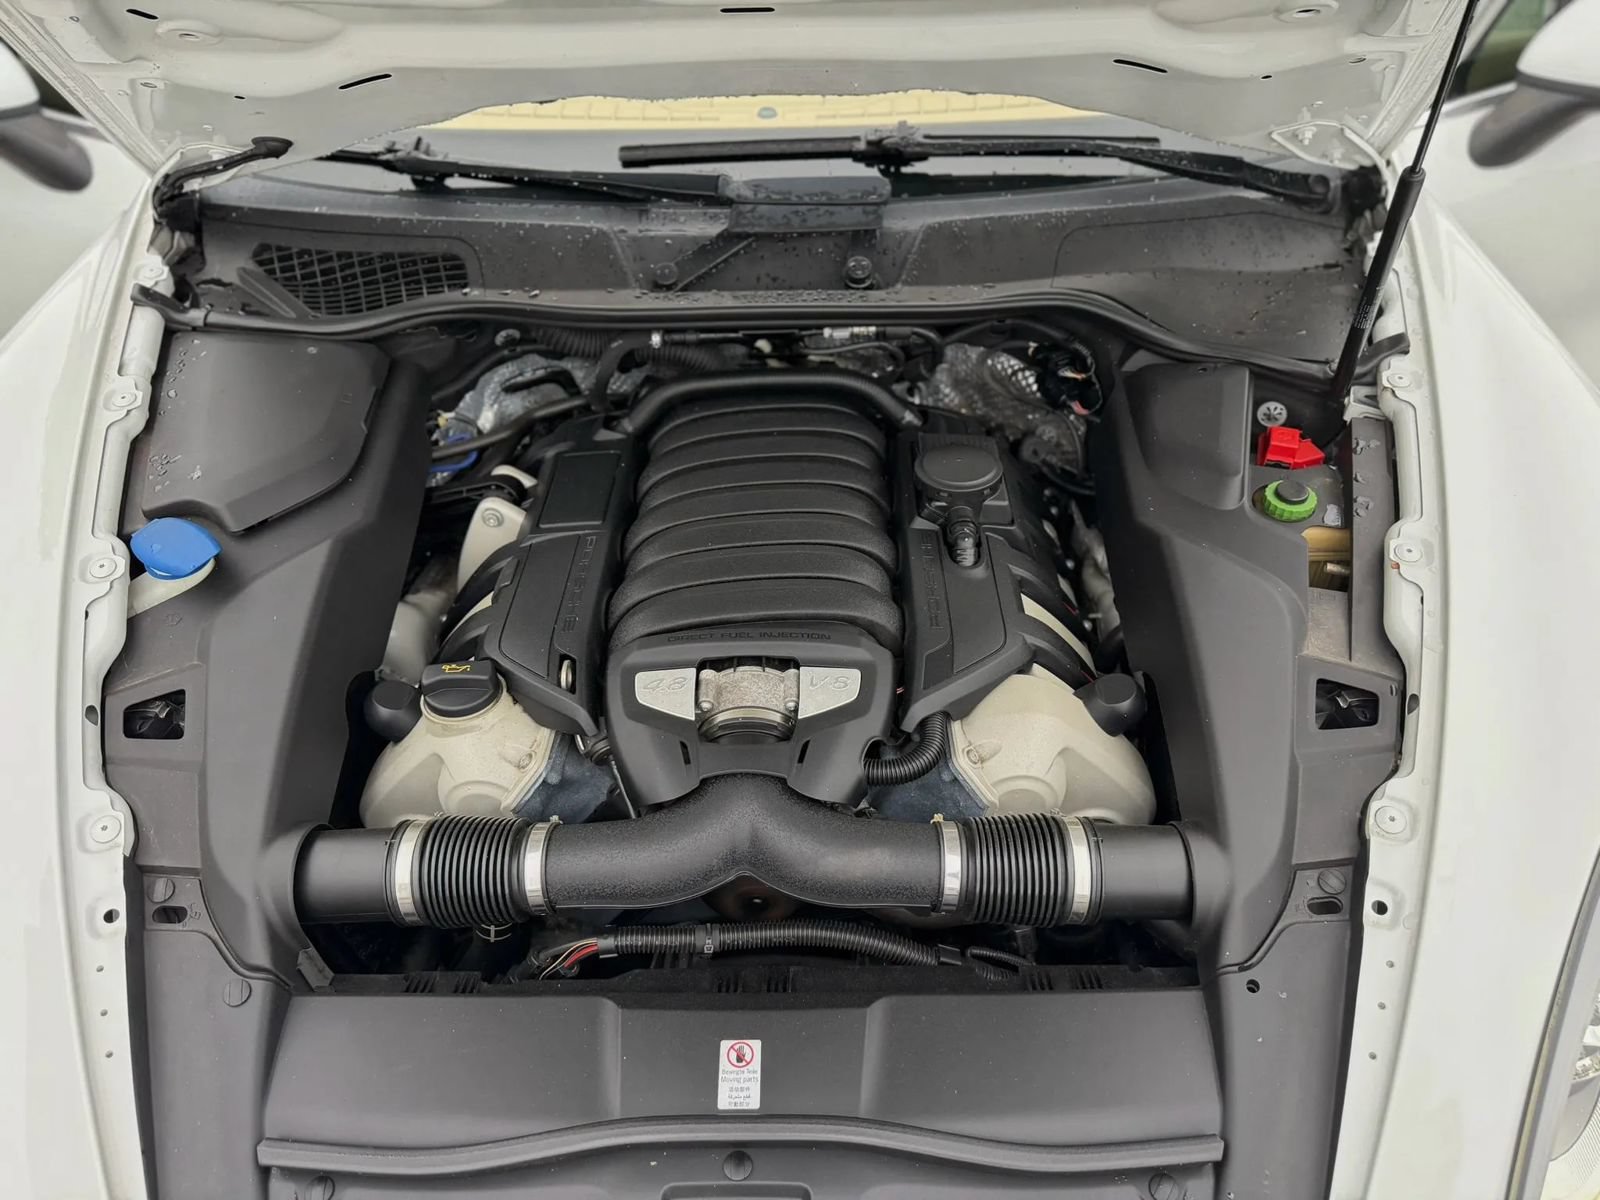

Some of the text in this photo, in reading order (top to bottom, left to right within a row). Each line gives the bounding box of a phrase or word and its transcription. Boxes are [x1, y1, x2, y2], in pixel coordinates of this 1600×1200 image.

[667, 631, 832, 642] DIRECT FUEL INJECTION
[643, 677, 688, 692] 4.8
[809, 675, 850, 690] V8
